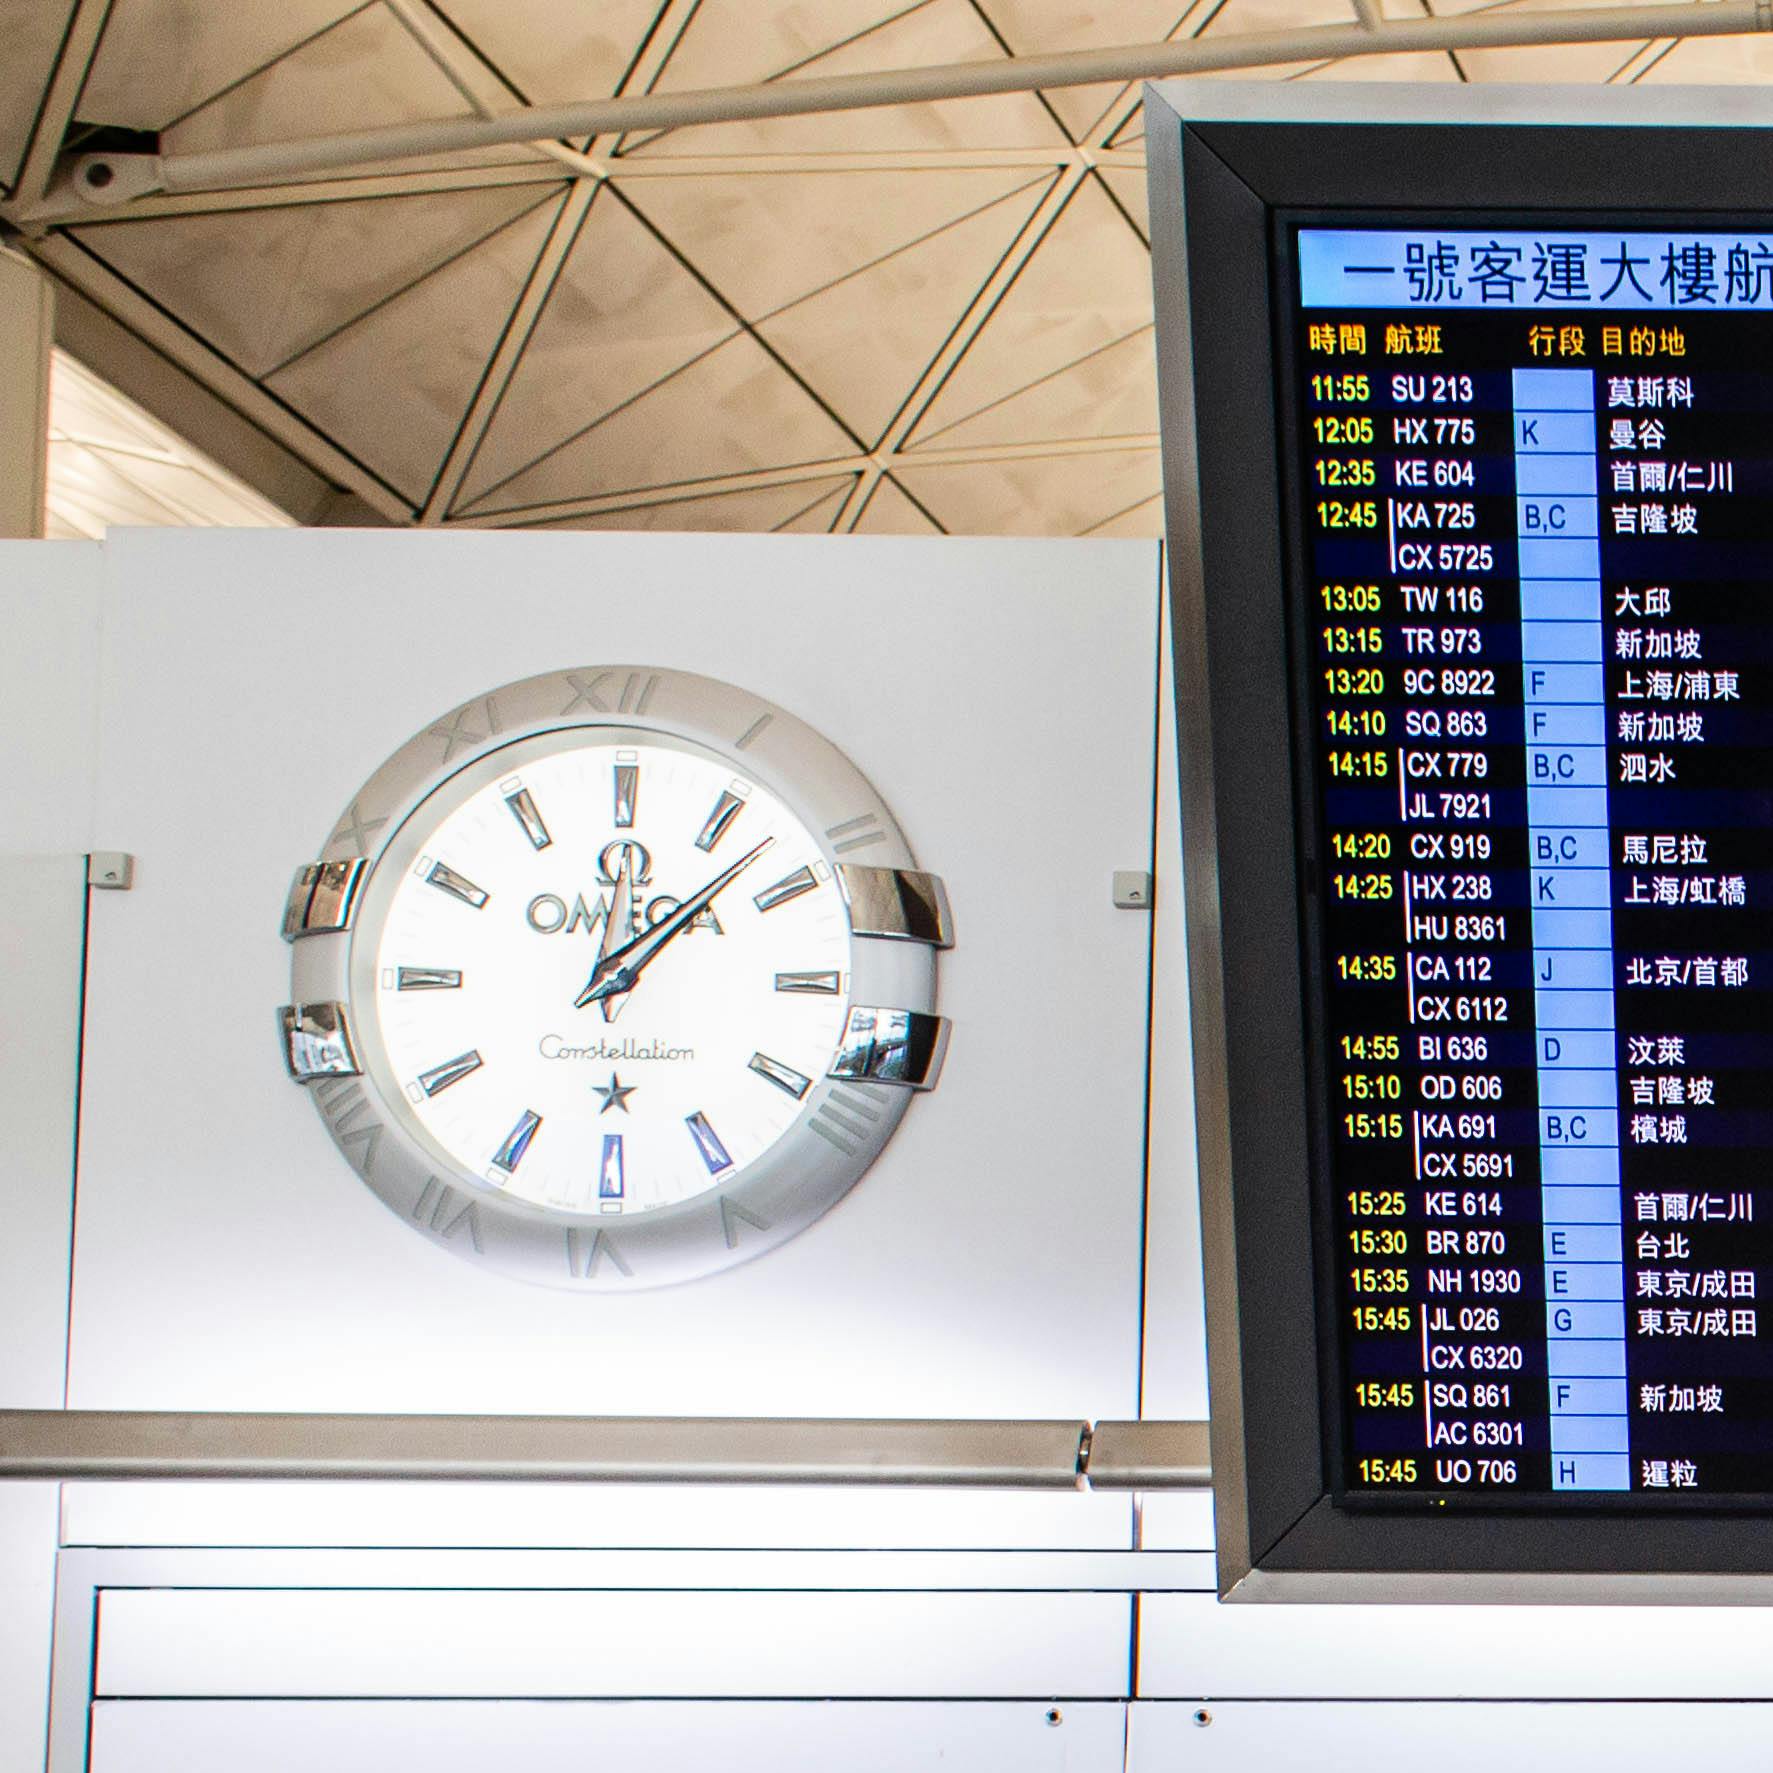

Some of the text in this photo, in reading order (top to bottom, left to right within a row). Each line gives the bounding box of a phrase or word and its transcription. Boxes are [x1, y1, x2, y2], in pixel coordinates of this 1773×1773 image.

[1309, 323, 1366, 354] 時間
[1385, 324, 1443, 354] 航班
[1529, 325, 1585, 356] 行段
[1603, 326, 1685, 356] 目的地
[1312, 374, 1370, 401] 11:55
[1392, 374, 1426, 402] SU
[1432, 375, 1473, 402] 213
[1608, 376, 1694, 408] 莫斯科
[1318, 501, 1377, 528] 12:45
[1397, 502, 1431, 528] KA
[1434, 502, 1476, 528] 725
[1526, 504, 1565, 533] B,C
[1612, 503, 1698, 534] 吉隆坡
[1325, 668, 1384, 694] 13:20
[1403, 669, 1435, 695] 9C
[1441, 669, 1494, 695] 8922
[1532, 671, 1545, 695] F
[1618, 670, 1740, 701] 上海/浦東
[539, 1033, 694, 1061] Constellation
[1360, 1459, 1417, 1482] 15:45
[1436, 1460, 1471, 1482] UO
[1477, 1460, 1516, 1483] 706
[1560, 1461, 1575, 1483] H
[1643, 1460, 1697, 1487] 暹粒
